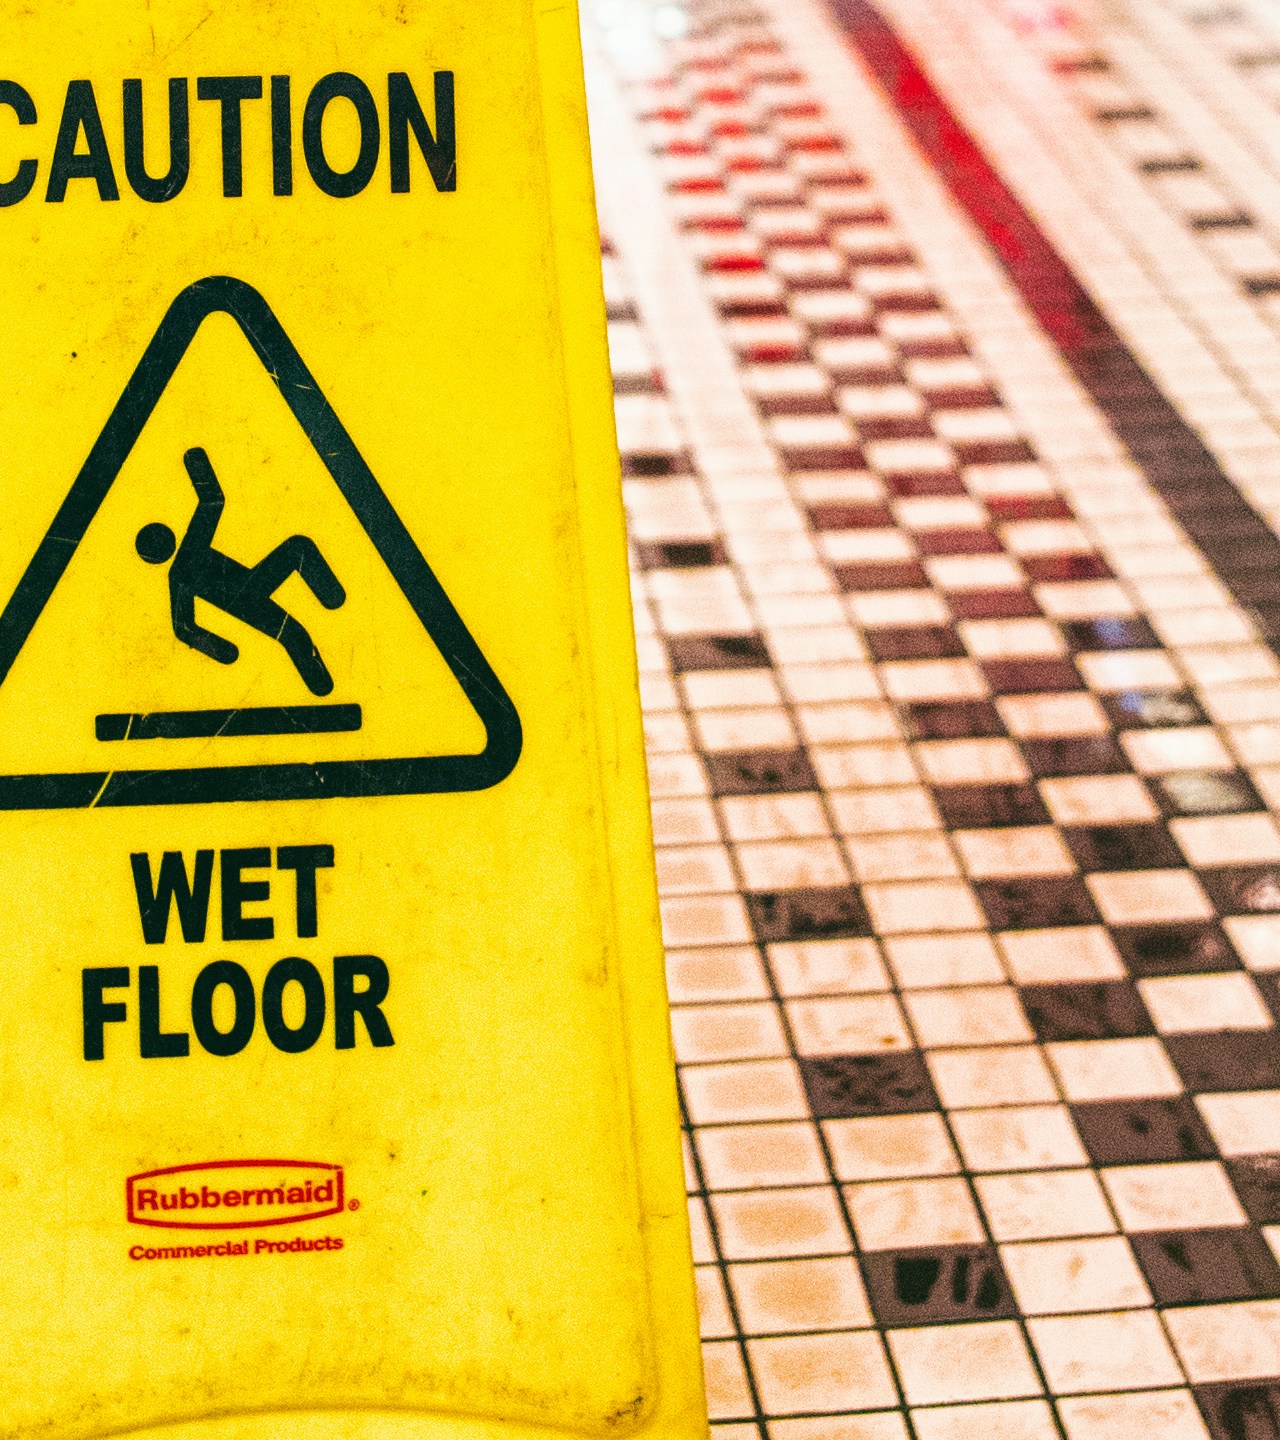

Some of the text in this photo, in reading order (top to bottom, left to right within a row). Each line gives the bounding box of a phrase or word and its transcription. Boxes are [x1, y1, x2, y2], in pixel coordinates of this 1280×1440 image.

[130, 844, 335, 945] WET
[81, 954, 395, 1062] FLOOR
[136, 1178, 335, 1212] Rubbermaid
[128, 1235, 345, 1262] Commercial Products
